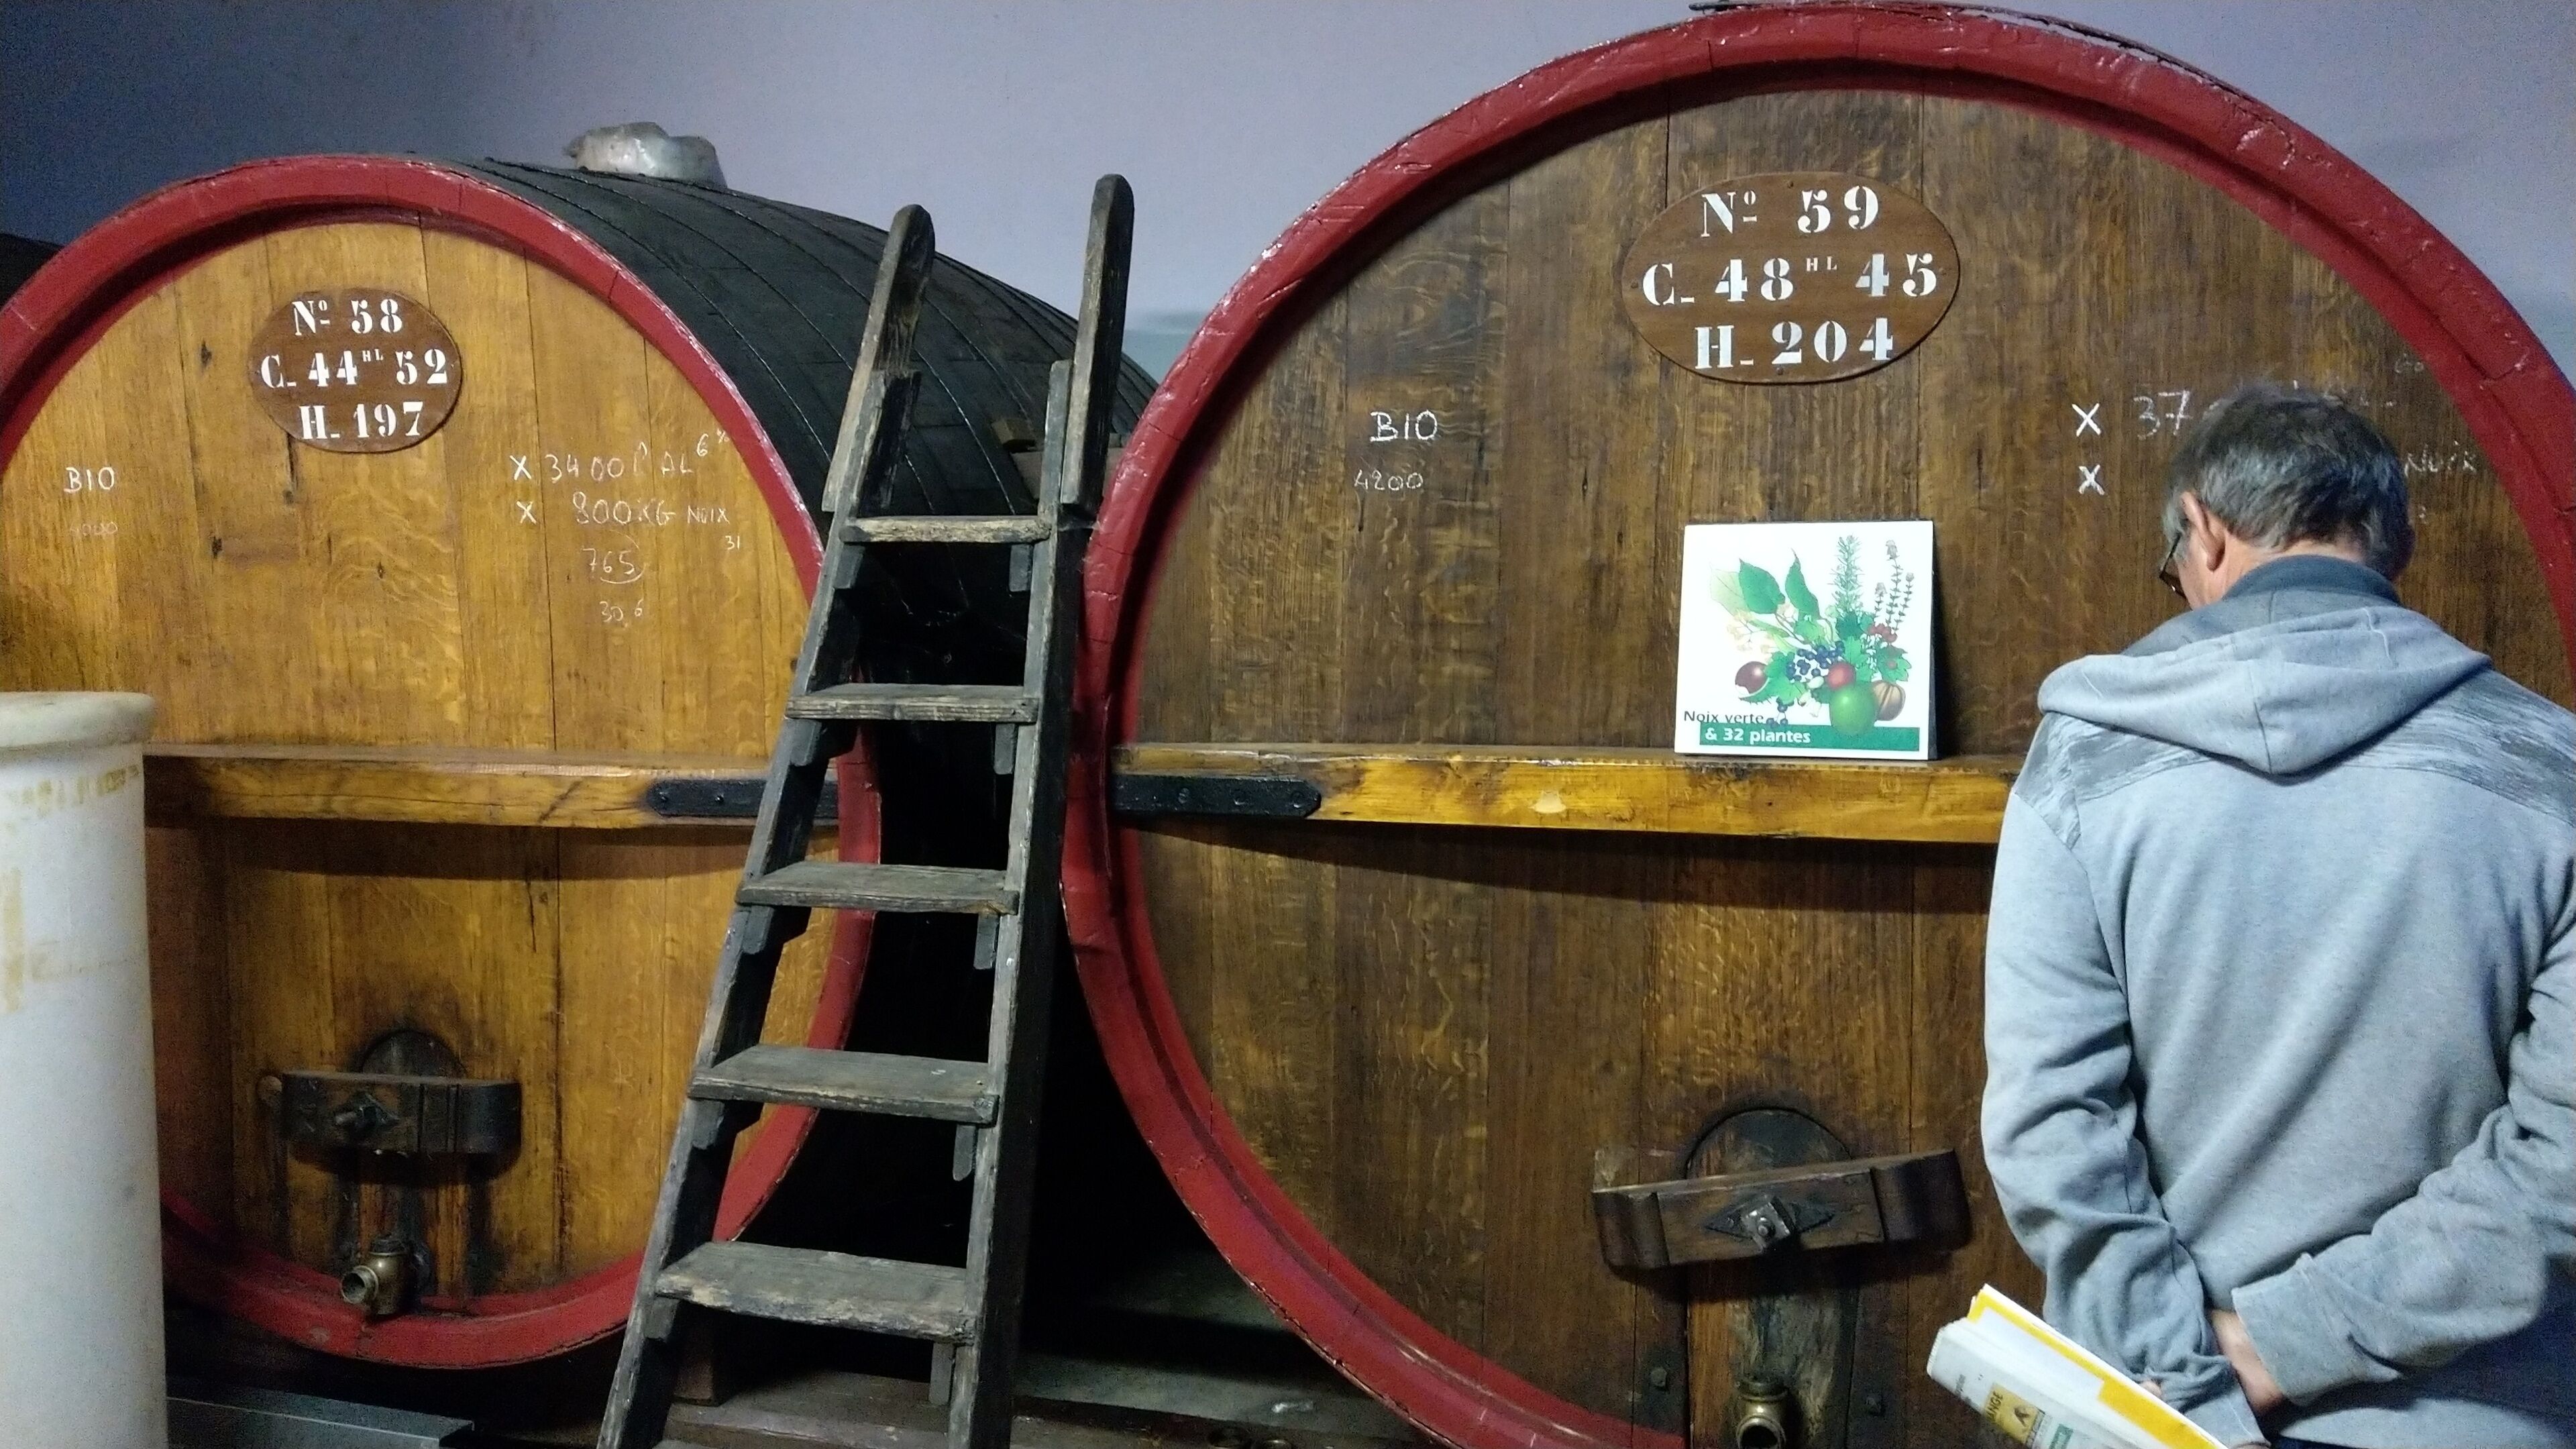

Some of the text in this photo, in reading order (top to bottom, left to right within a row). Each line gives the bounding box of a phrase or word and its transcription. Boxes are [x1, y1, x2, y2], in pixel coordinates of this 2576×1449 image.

[1796, 184, 1879, 234] 59
[1714, 258, 1794, 303] 48
[1854, 252, 1937, 298] 45
[350, 299, 403, 334] 58
[1771, 317, 1894, 365] 204
[308, 350, 358, 388] 44
[395, 348, 448, 385] 52
[353, 400, 424, 439] 197
[1369, 409, 1438, 443] BIO
[62, 466, 115, 494] BIO
[544, 453, 625, 484] 3400
[1353, 468, 1424, 491] 4200
[724, 535, 741, 550] 31
[582, 547, 636, 575] 765
[1683, 710, 1720, 724] Noix
[1705, 727, 1812, 745] & 32 plantes
